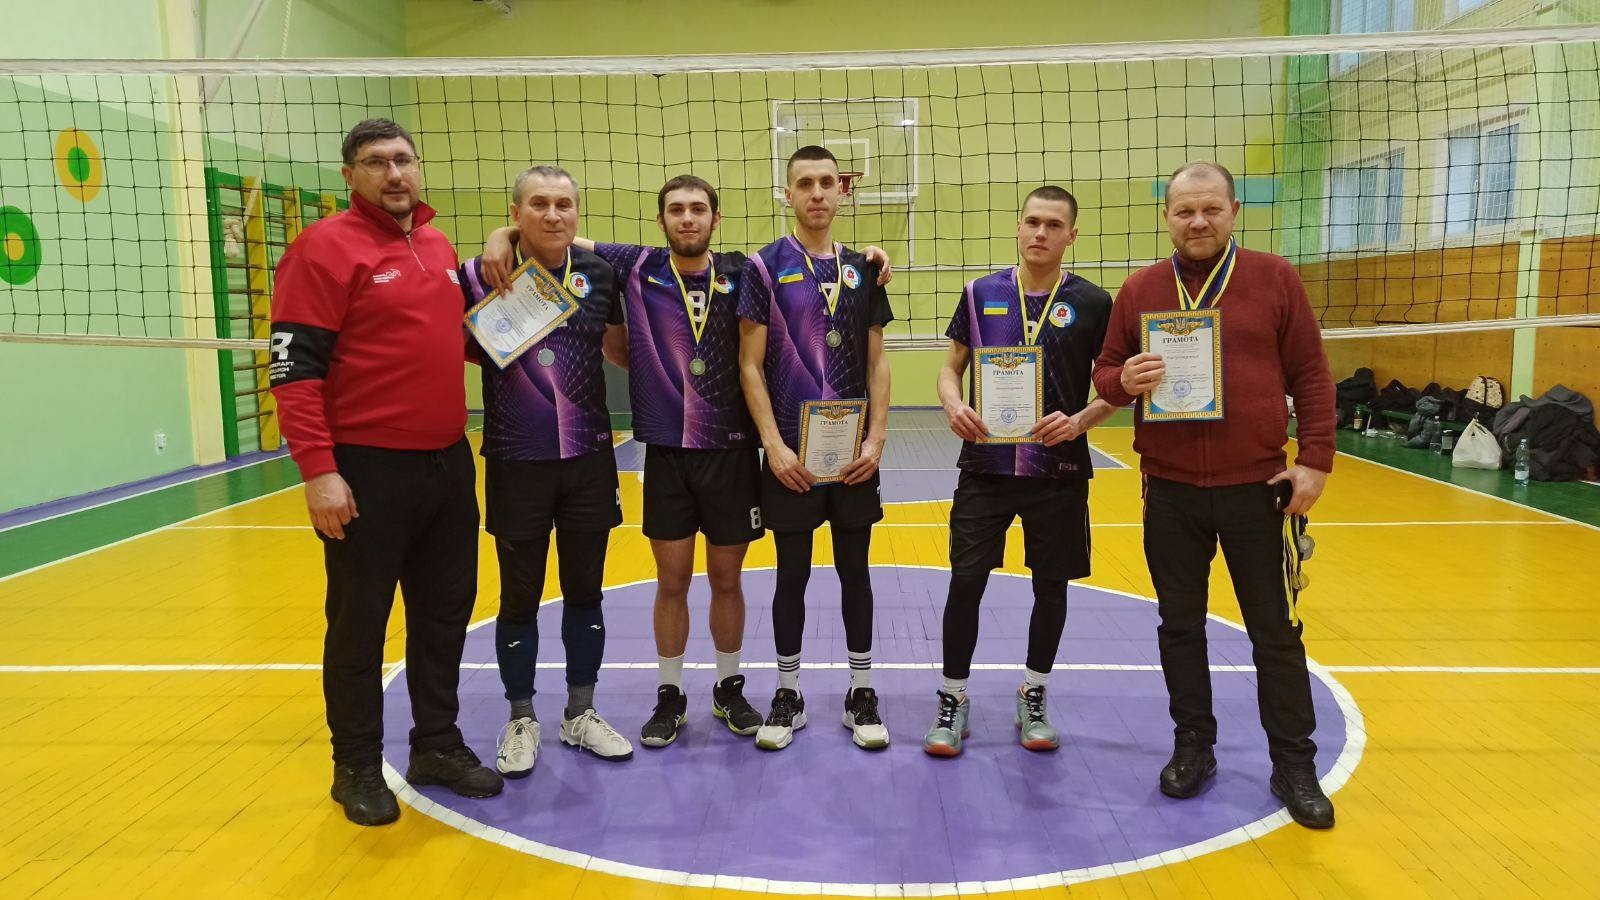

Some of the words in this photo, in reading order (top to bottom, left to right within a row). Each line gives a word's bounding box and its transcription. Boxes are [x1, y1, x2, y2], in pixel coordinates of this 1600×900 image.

[526, 284, 549, 311] ГРАМОТА
[687, 291, 706, 322] 8
[1162, 336, 1199, 344] ГРАМОТА
[750, 506, 761, 529] 8
